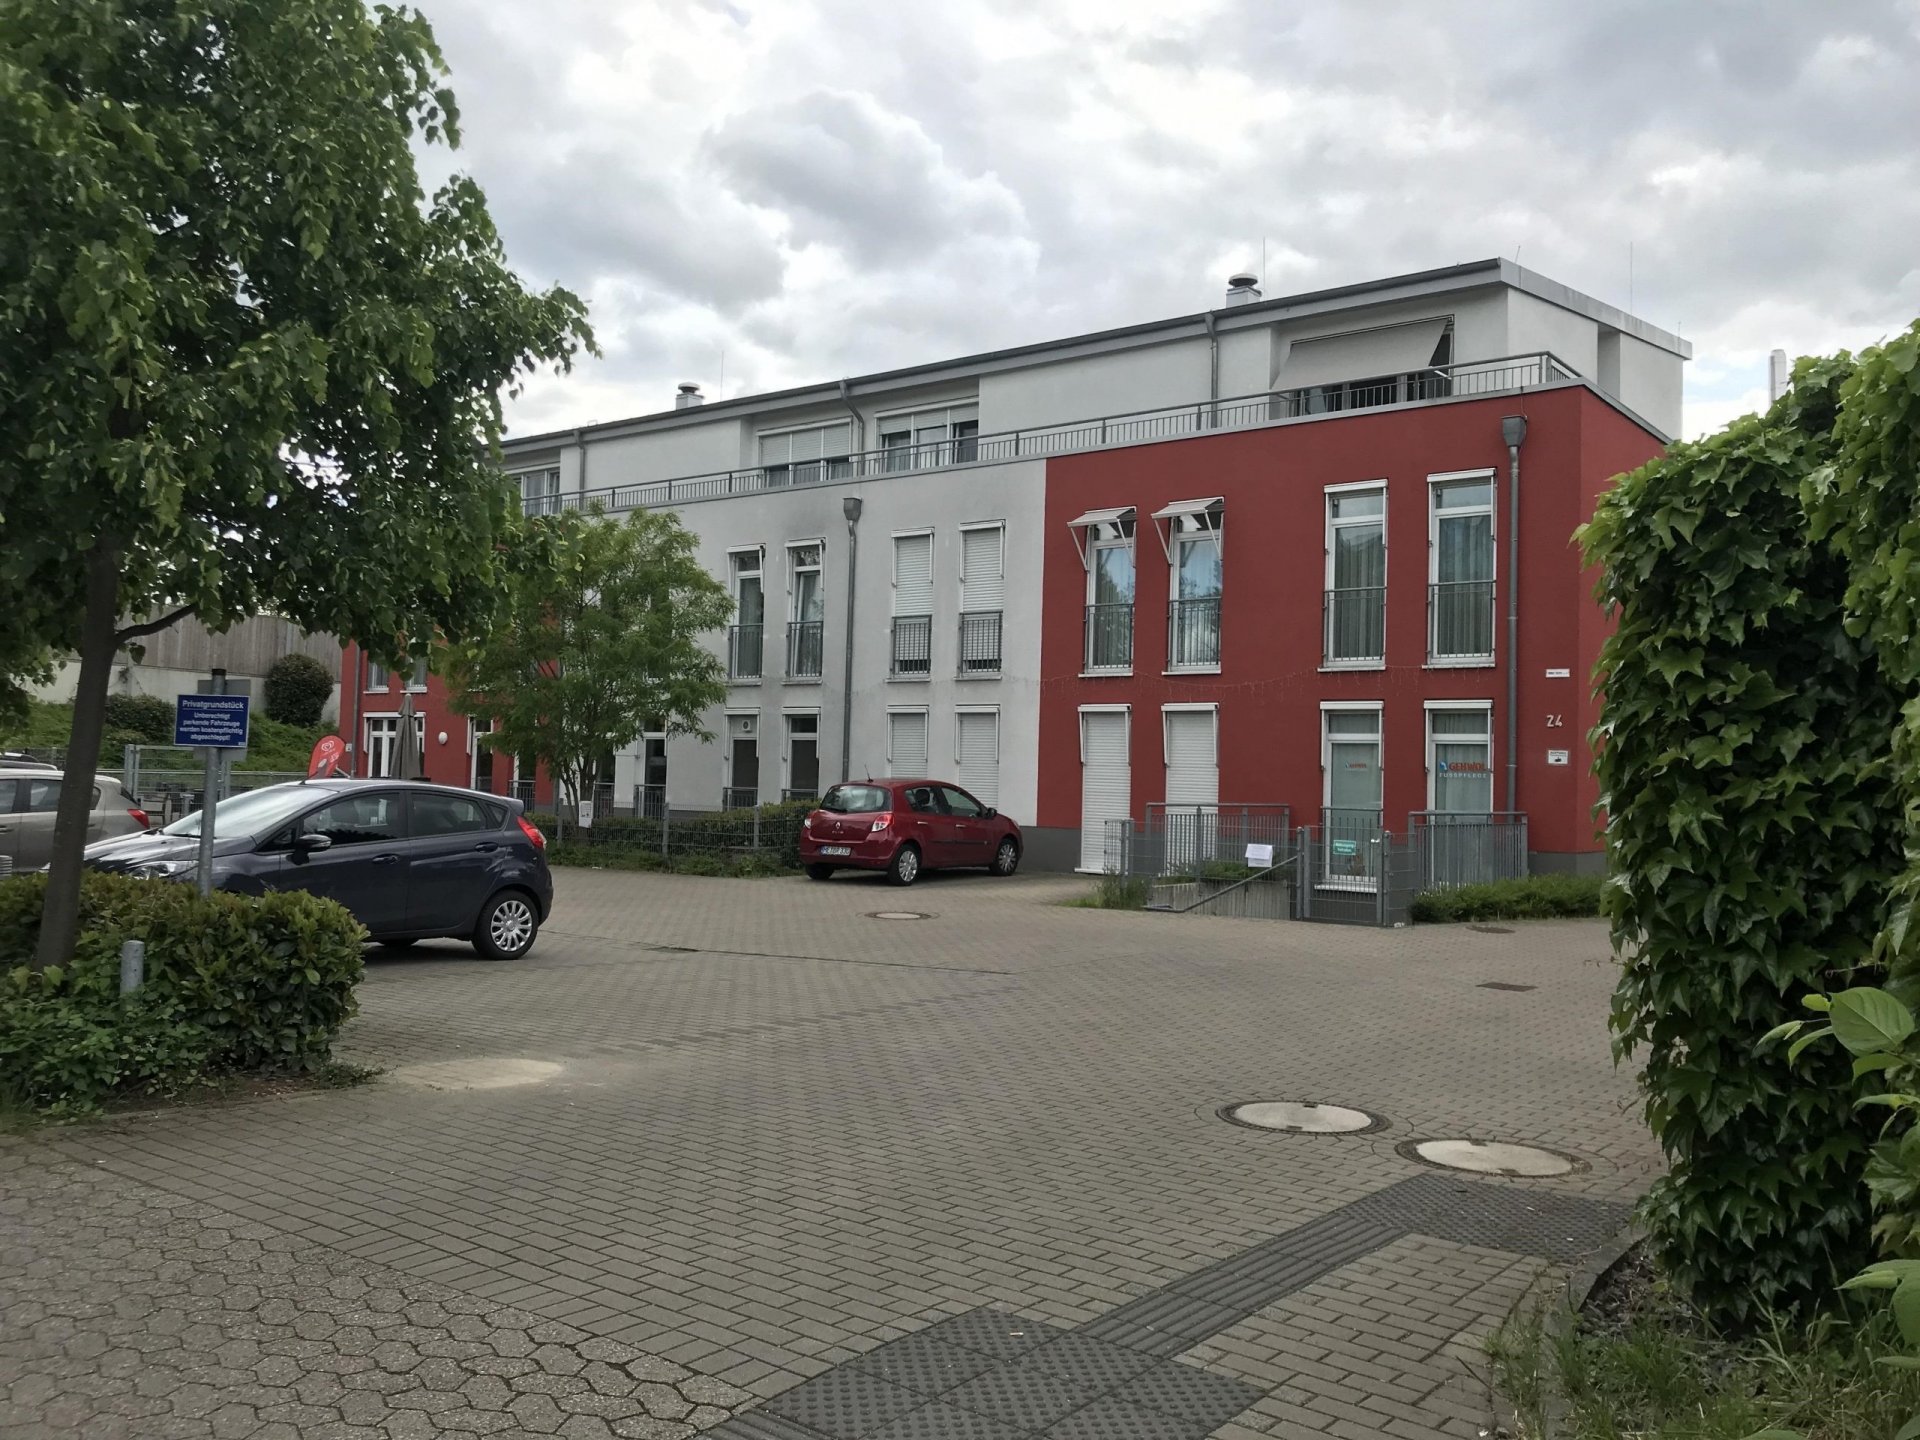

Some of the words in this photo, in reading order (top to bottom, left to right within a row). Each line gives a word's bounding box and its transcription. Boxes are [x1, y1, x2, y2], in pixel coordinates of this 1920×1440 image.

[182, 700, 244, 709] Privatgrundstück
[1546, 714, 1563, 727] 24
[200, 726, 243, 735] kostenpflichtig
